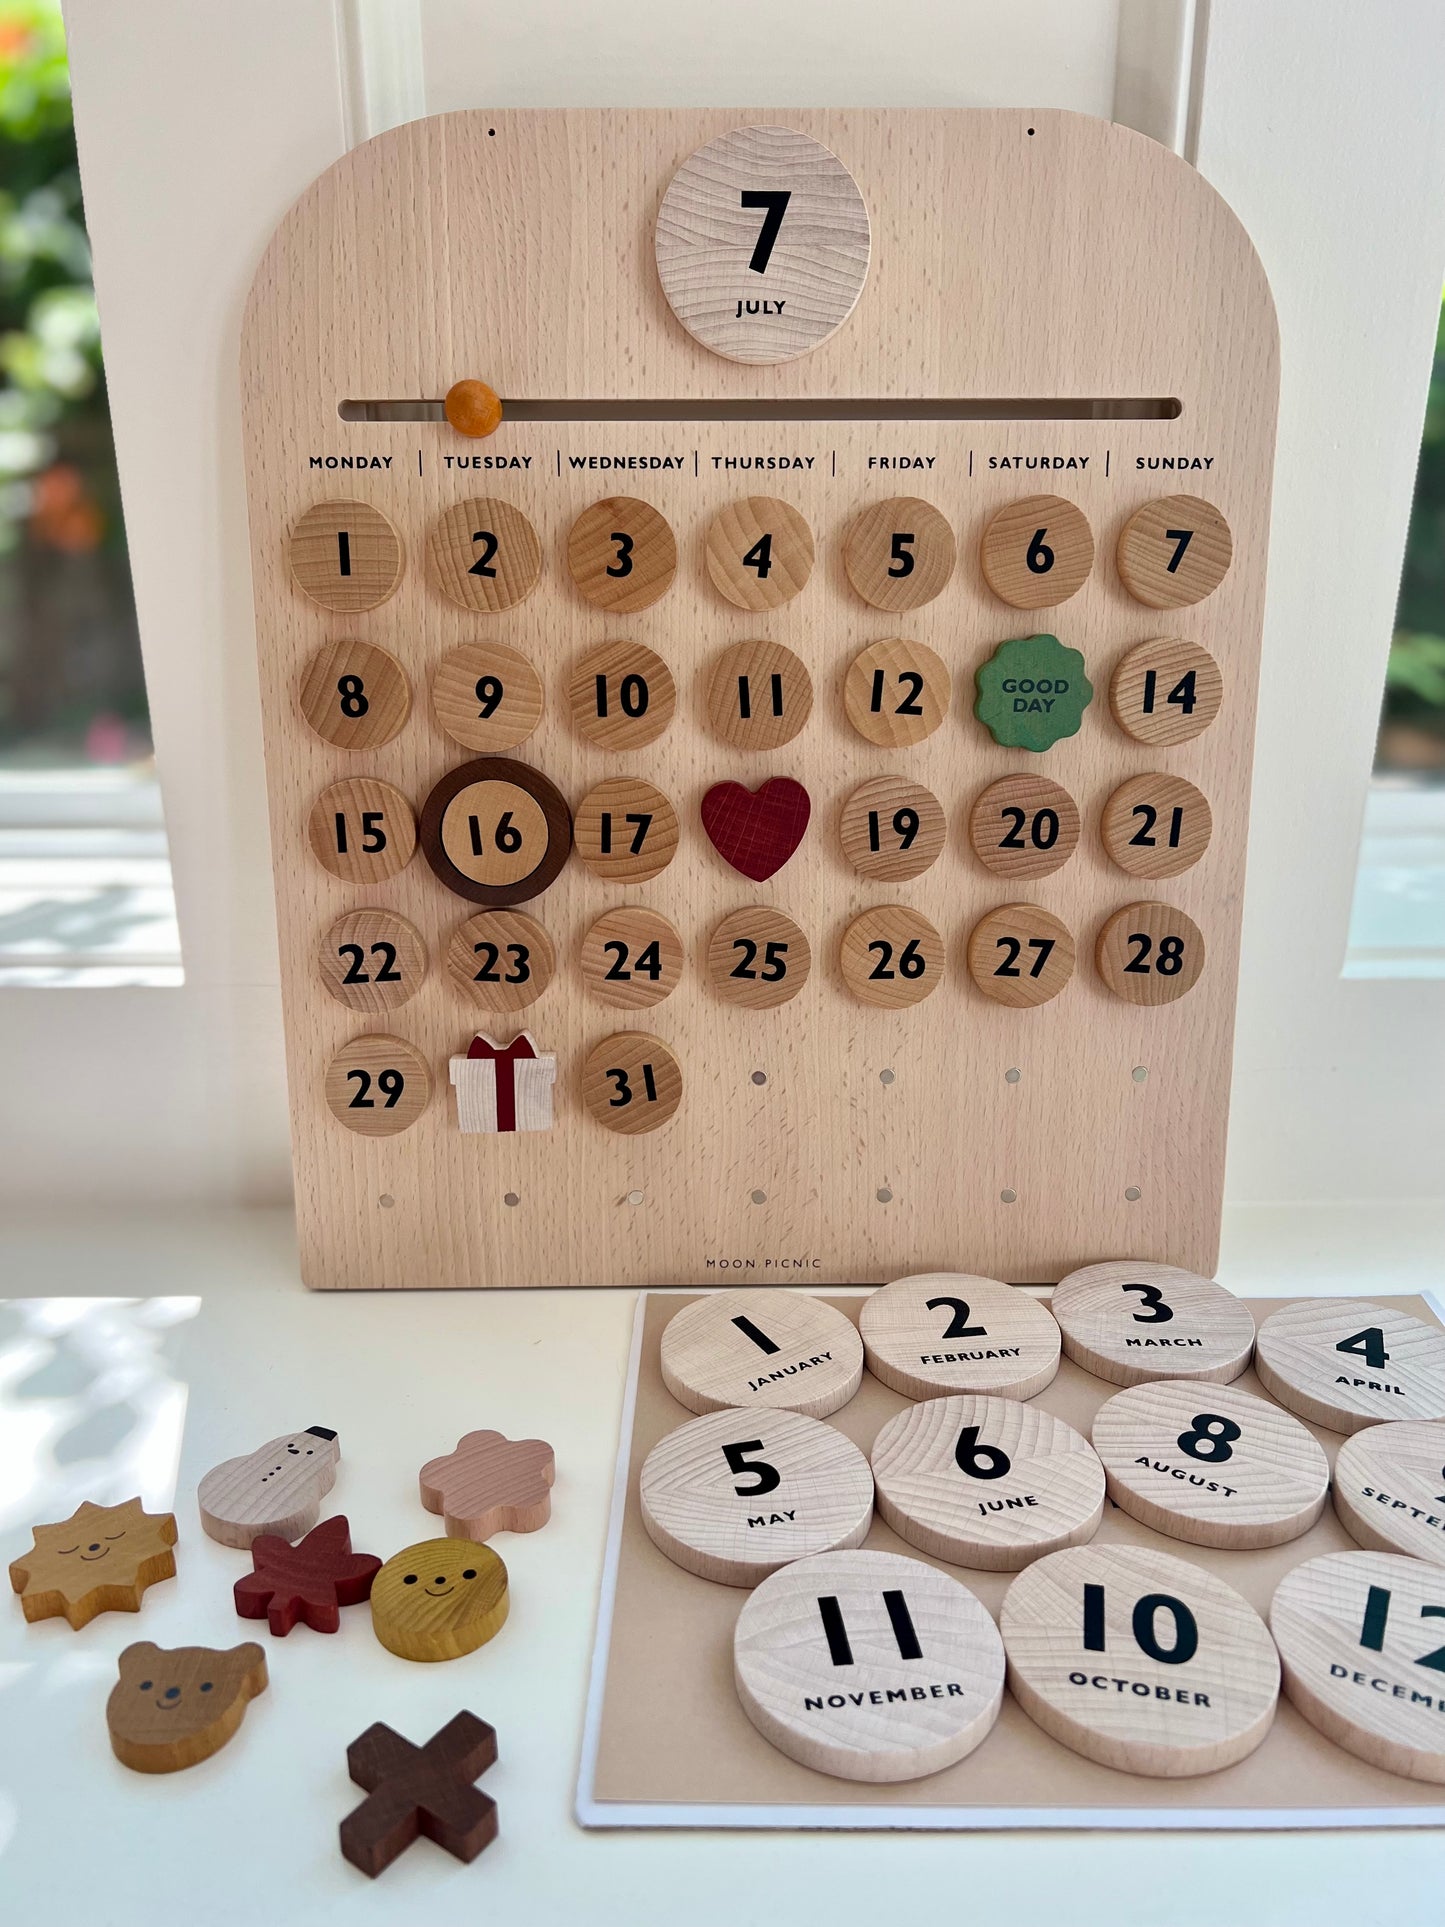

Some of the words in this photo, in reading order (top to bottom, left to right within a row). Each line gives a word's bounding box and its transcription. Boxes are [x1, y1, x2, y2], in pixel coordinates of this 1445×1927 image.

[740, 190, 792, 275] 7
[735, 299, 786, 319] JULY
[309, 456, 393, 470] MONDAY
[443, 456, 533, 470] TUESDAY
[568, 456, 685, 470] WEDNESDAY
[711, 456, 815, 470] THURSDAY
[868, 456, 936, 470] FRIDAY
[988, 456, 1090, 470] SATURDAY
[1135, 457, 1215, 470] SUNDAY
[337, 531, 352, 577] 1
[467, 530, 499, 579] 2
[606, 531, 635, 578] 3
[742, 533, 773, 579] 4
[887, 532, 915, 579] 5
[1026, 527, 1055, 575] 6
[1165, 529, 1195, 574] 7
[336, 674, 370, 719] 8
[475, 675, 504, 719] 9
[595, 673, 650, 719] 10
[738, 673, 784, 719] 11
[870, 669, 924, 716] 12
[1001, 678, 1070, 695] GOOD
[1012, 697, 1056, 714] DAY
[1142, 669, 1197, 715] 14
[334, 811, 387, 854] 15
[468, 811, 523, 857] 16
[600, 812, 653, 855] 17
[868, 807, 920, 852] 19
[997, 806, 1060, 850] 20
[1128, 804, 1184, 848] 21
[338, 941, 402, 985] 22
[472, 941, 531, 985] 23
[604, 940, 663, 981] 24
[729, 938, 789, 983] 25
[868, 939, 926, 980] 26
[992, 936, 1056, 979] 27
[1123, 932, 1185, 976] 28
[347, 1068, 405, 1109] 29
[605, 1063, 658, 1107] 31
[705, 1258, 756, 1269] MOON
[764, 1258, 821, 1269] PICNIC
[925, 1296, 988, 1339] 2
[1121, 1283, 1174, 1324] 3
[730, 1315, 782, 1356] 1
[920, 1347, 1020, 1365] FEBRUARY
[1125, 1337, 1204, 1348] MARCH
[1335, 1327, 1390, 1370] 4
[747, 1350, 834, 1392] JANUARY
[1335, 1374, 1406, 1396] APRIL
[954, 1425, 1011, 1480] 6
[1176, 1413, 1242, 1463] 8
[721, 1439, 781, 1497] 5
[1134, 1456, 1238, 1497] AUGUST
[747, 1510, 796, 1529] MAY
[978, 1495, 1039, 1516] JUNE
[1361, 1486, 1445, 1531] SEPTE
[817, 1589, 924, 1667] 11
[1083, 1582, 1199, 1665] 10
[804, 1683, 964, 1711] NOVEMBER
[1068, 1671, 1211, 1709] OCTOBER
